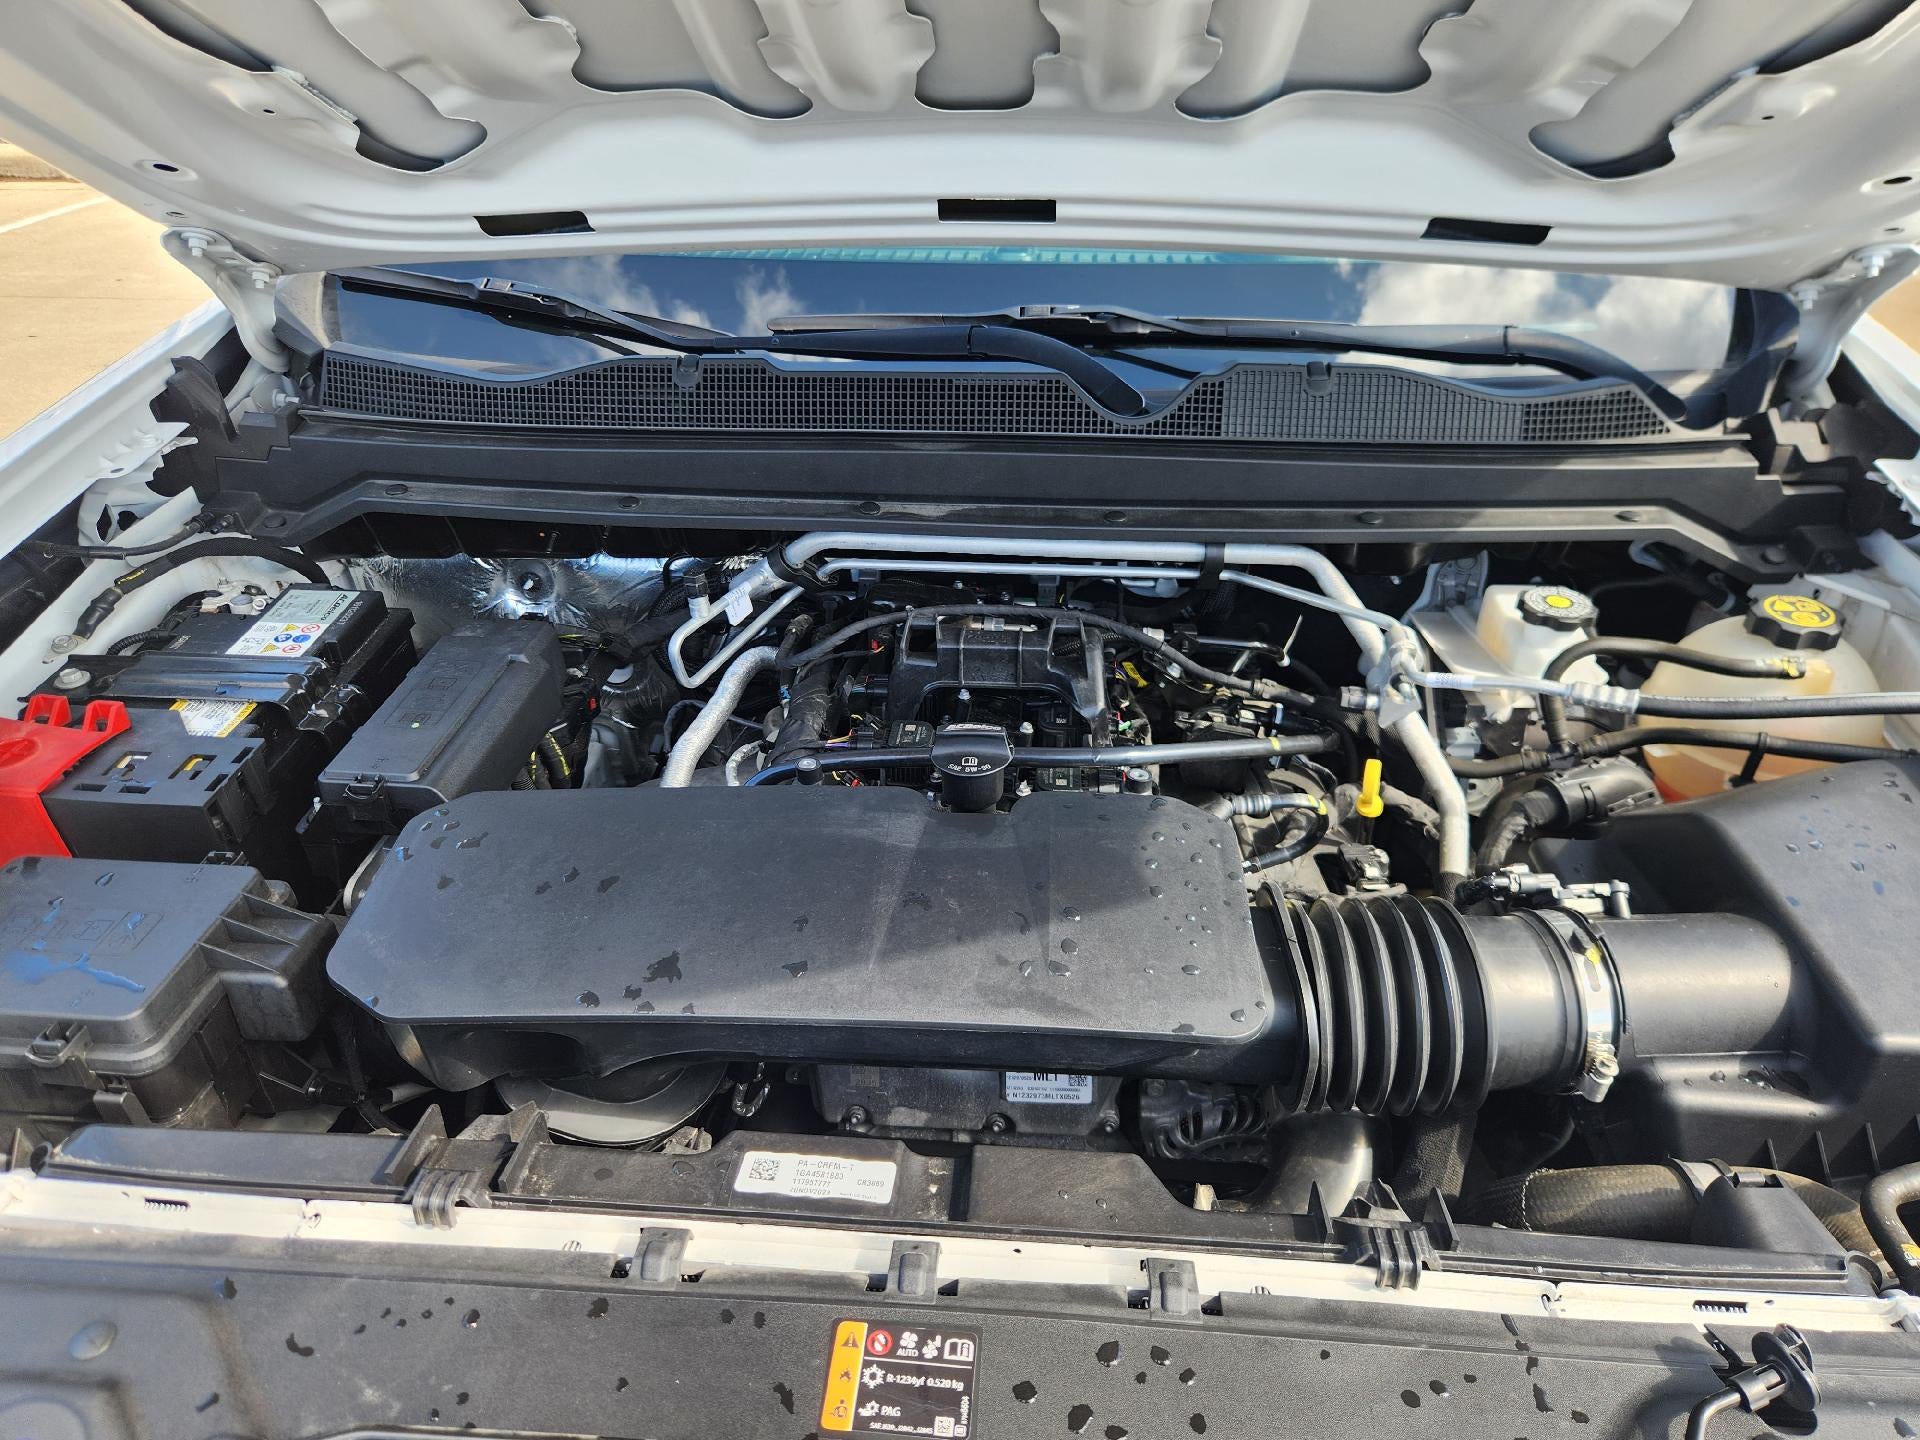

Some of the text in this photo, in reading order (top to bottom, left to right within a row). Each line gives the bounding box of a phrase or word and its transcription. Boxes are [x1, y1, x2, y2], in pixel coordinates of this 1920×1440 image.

[321, 594, 348, 620] ACDelco
[948, 763, 962, 772] SAE
[896, 1348, 919, 1357] AUTO
[886, 1373, 964, 1392] R-1234yf 0.520 kg
[880, 1405, 902, 1417] PAG
